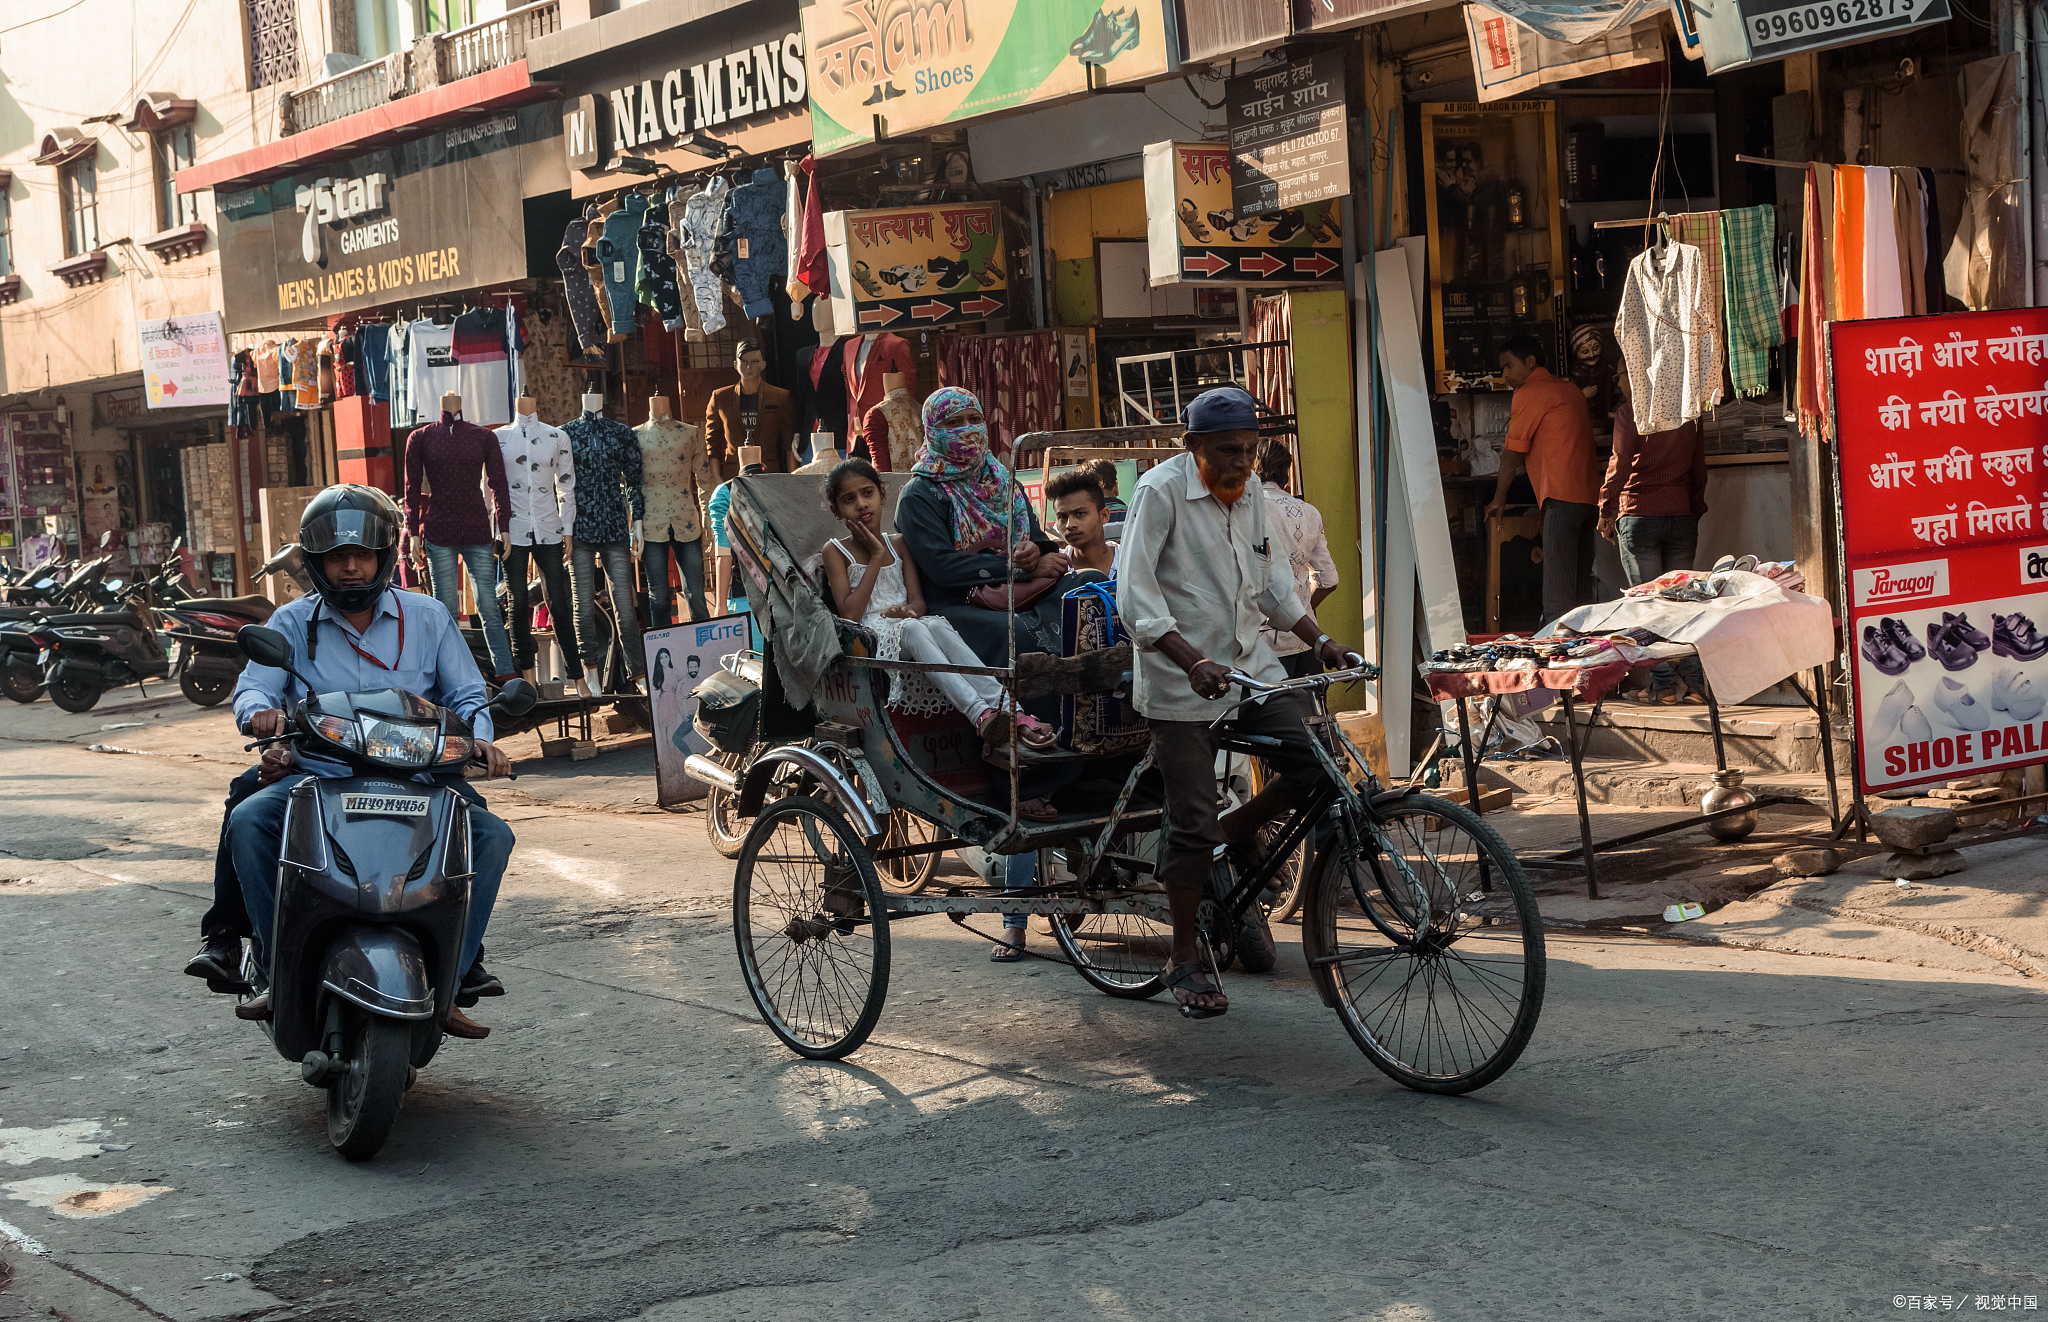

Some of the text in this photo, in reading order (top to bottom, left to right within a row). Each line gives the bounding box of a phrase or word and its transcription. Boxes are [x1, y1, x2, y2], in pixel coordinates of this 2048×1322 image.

[914, 64, 974, 95] Shoes
[1254, 58, 1313, 92] महाराष्ट्र ट्रेडर्स
[611, 68, 686, 151] NAG
[1241, 80, 1329, 118] वाईन शॉप
[1443, 103, 1455, 113] AB
[1457, 102, 1476, 112] HOGI
[1512, 101, 1520, 111] KI
[1522, 101, 1547, 111] PARTY
[1296, 137, 1305, 148] 72
[1330, 128, 1339, 140] 67
[341, 218, 399, 255] GARMENTS
[850, 207, 995, 252] सत्यम शुज
[319, 267, 365, 303] LADIES
[366, 264, 377, 293] &
[378, 255, 414, 291] KID'S
[415, 246, 461, 283] WEAR
[1865, 326, 2048, 379] शादी और त्यौहा
[1878, 394, 1911, 431] की
[1919, 389, 1967, 427] नयी
[1868, 452, 1917, 489] और
[1923, 445, 1974, 484] सभी
[1980, 447, 2034, 487] स्कुल
[1966, 494, 2032, 536] मिलते
[1867, 568, 1936, 600] Paragon
[698, 624, 743, 643] FLITE
[1884, 734, 1974, 777] SHOE
[363, 781, 406, 790] HONDA
